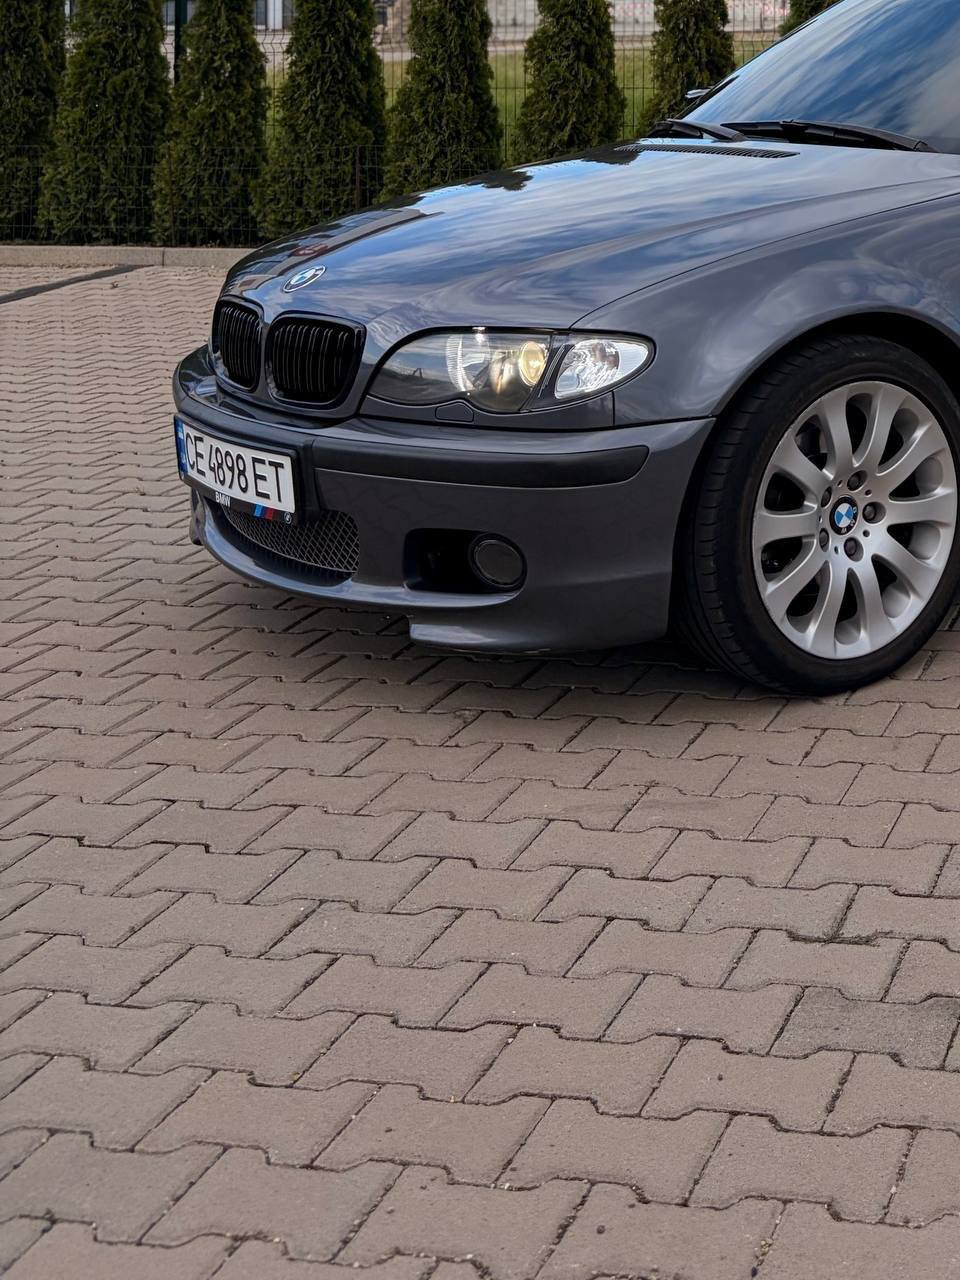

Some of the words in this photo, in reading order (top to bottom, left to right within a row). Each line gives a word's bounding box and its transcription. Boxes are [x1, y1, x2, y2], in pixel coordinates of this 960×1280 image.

[185, 431, 206, 478] CE
[208, 443, 249, 494] 4898
[251, 456, 285, 503] ET
[215, 491, 231, 508] BMW
